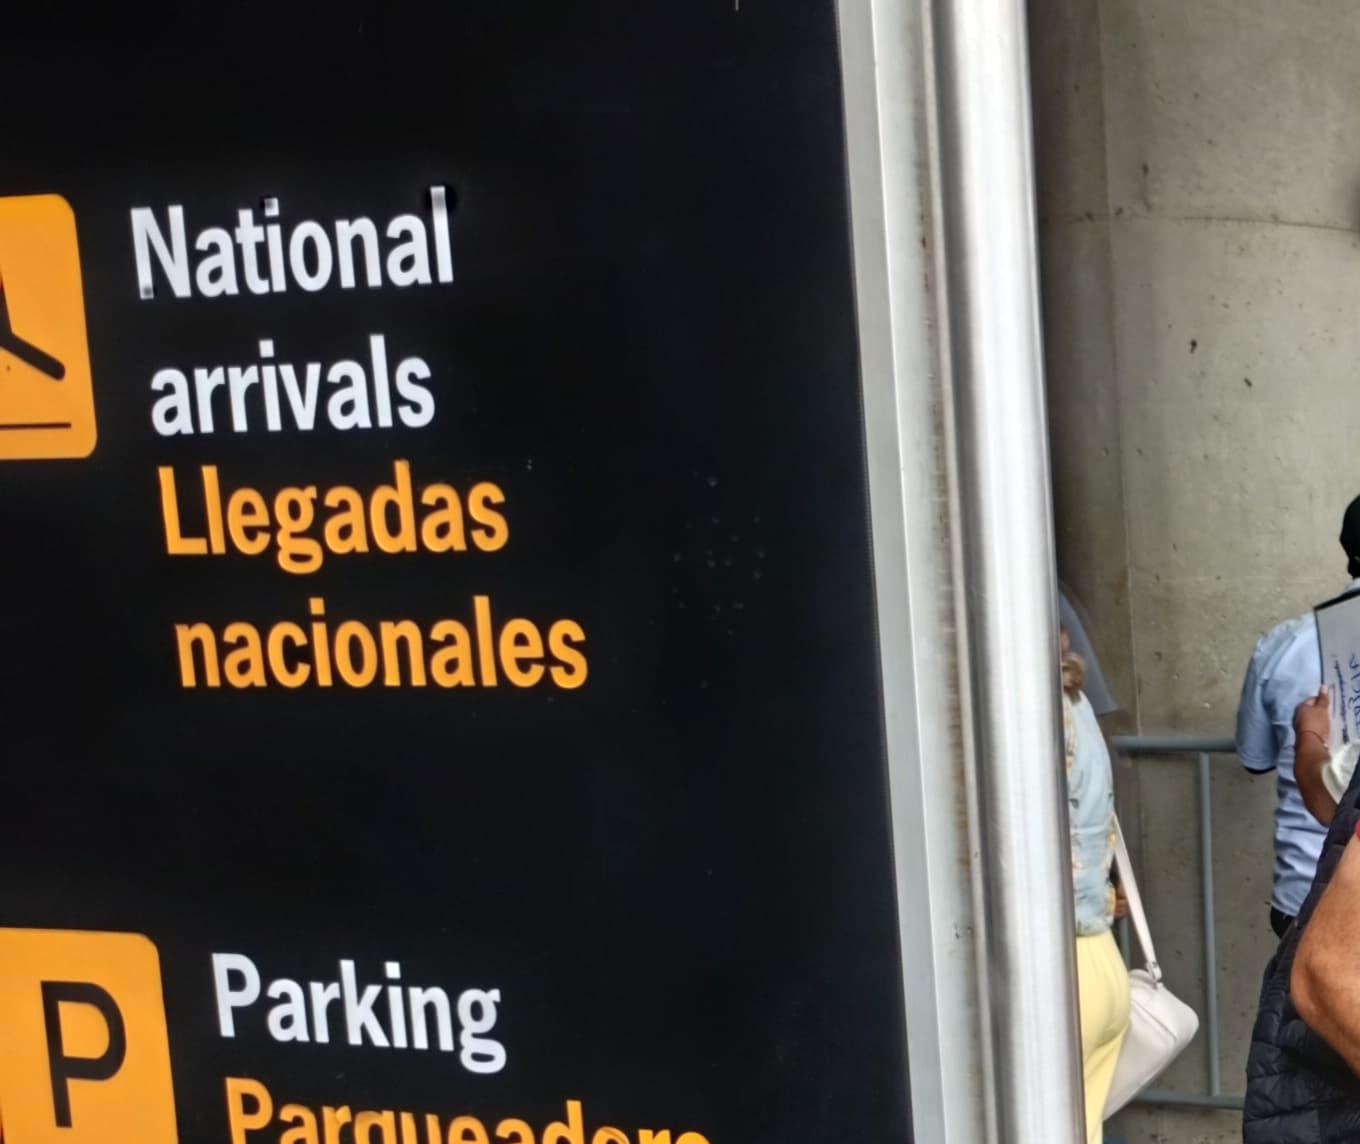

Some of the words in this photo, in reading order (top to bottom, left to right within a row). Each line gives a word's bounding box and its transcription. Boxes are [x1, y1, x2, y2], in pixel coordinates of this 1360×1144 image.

[130, 186, 454, 300] National
[150, 335, 436, 436] arrivals
[158, 459, 510, 575] Llegadas
[174, 596, 589, 690] nacionales
[40, 979, 127, 1128] P
[210, 952, 507, 1074] Parking
